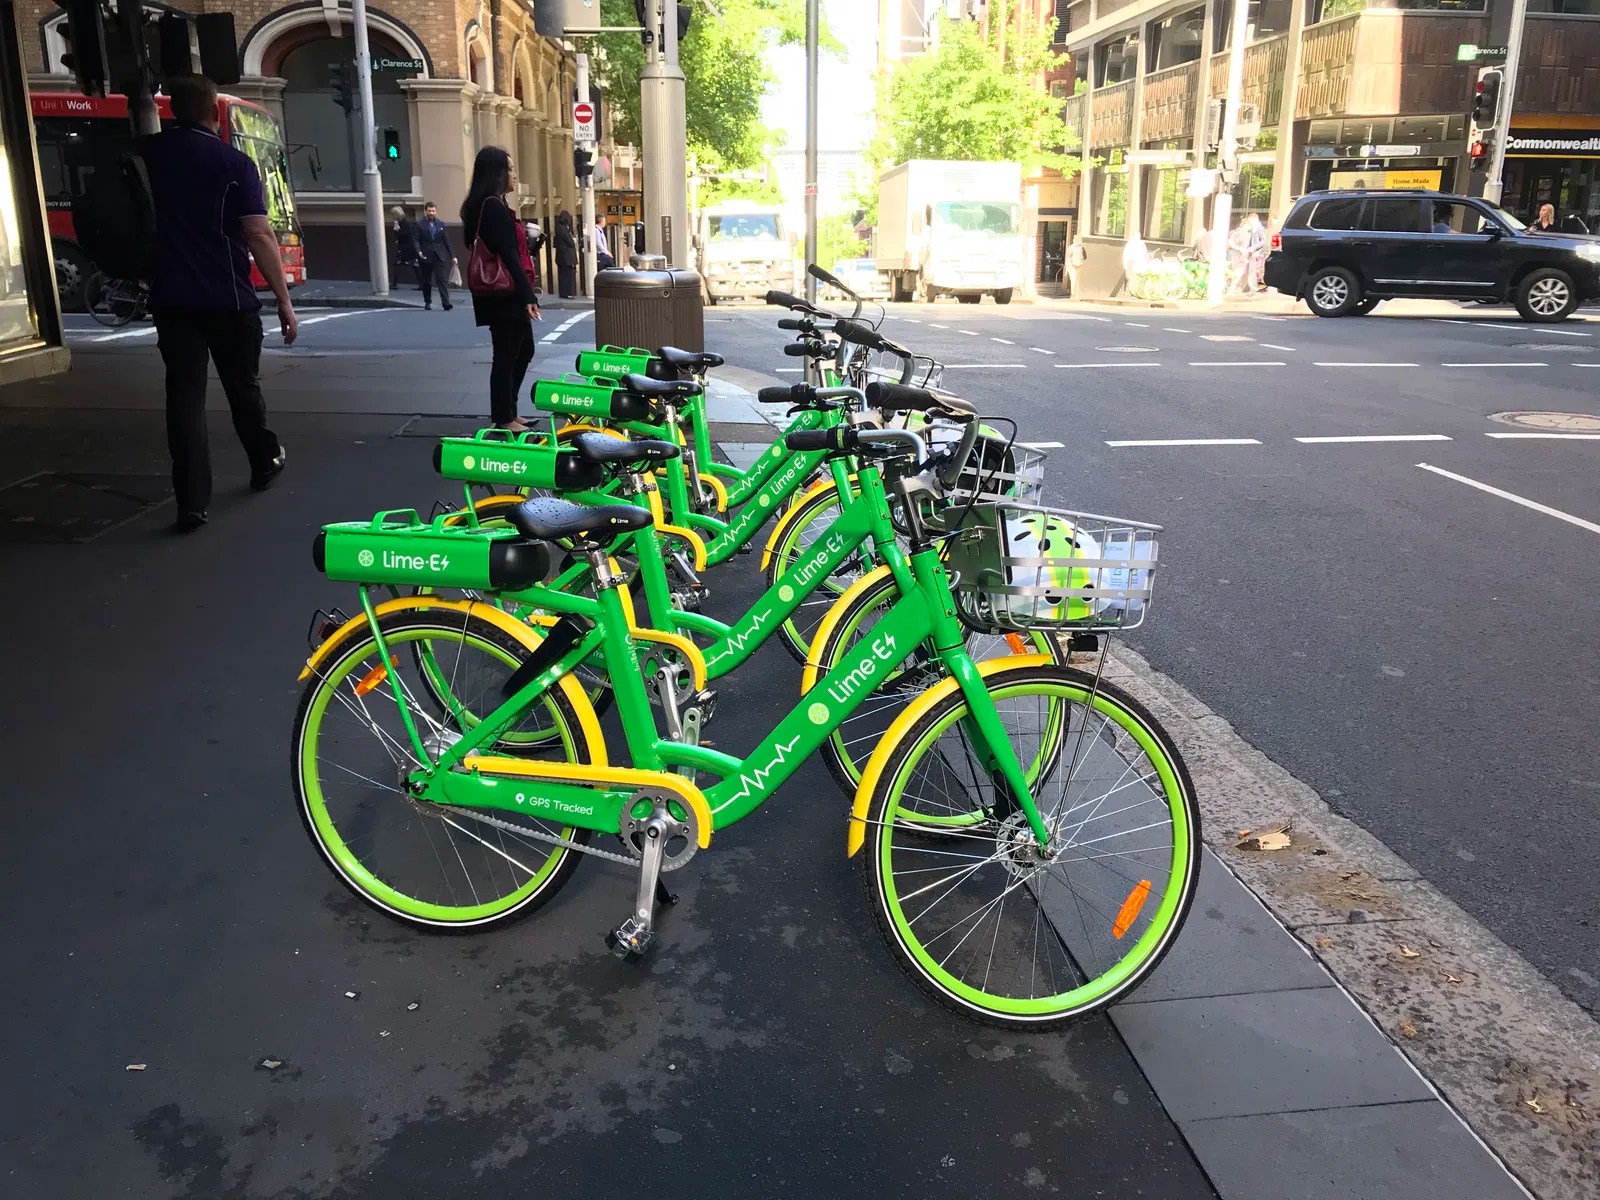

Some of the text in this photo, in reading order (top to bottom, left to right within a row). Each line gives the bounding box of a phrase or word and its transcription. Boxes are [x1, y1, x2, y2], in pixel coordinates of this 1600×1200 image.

[381, 58, 422, 68] Clarence St
[66, 100, 92, 110] Work
[1504, 135, 1600, 150] Commonwealt
[529, 796, 593, 815] GPS Tracked
